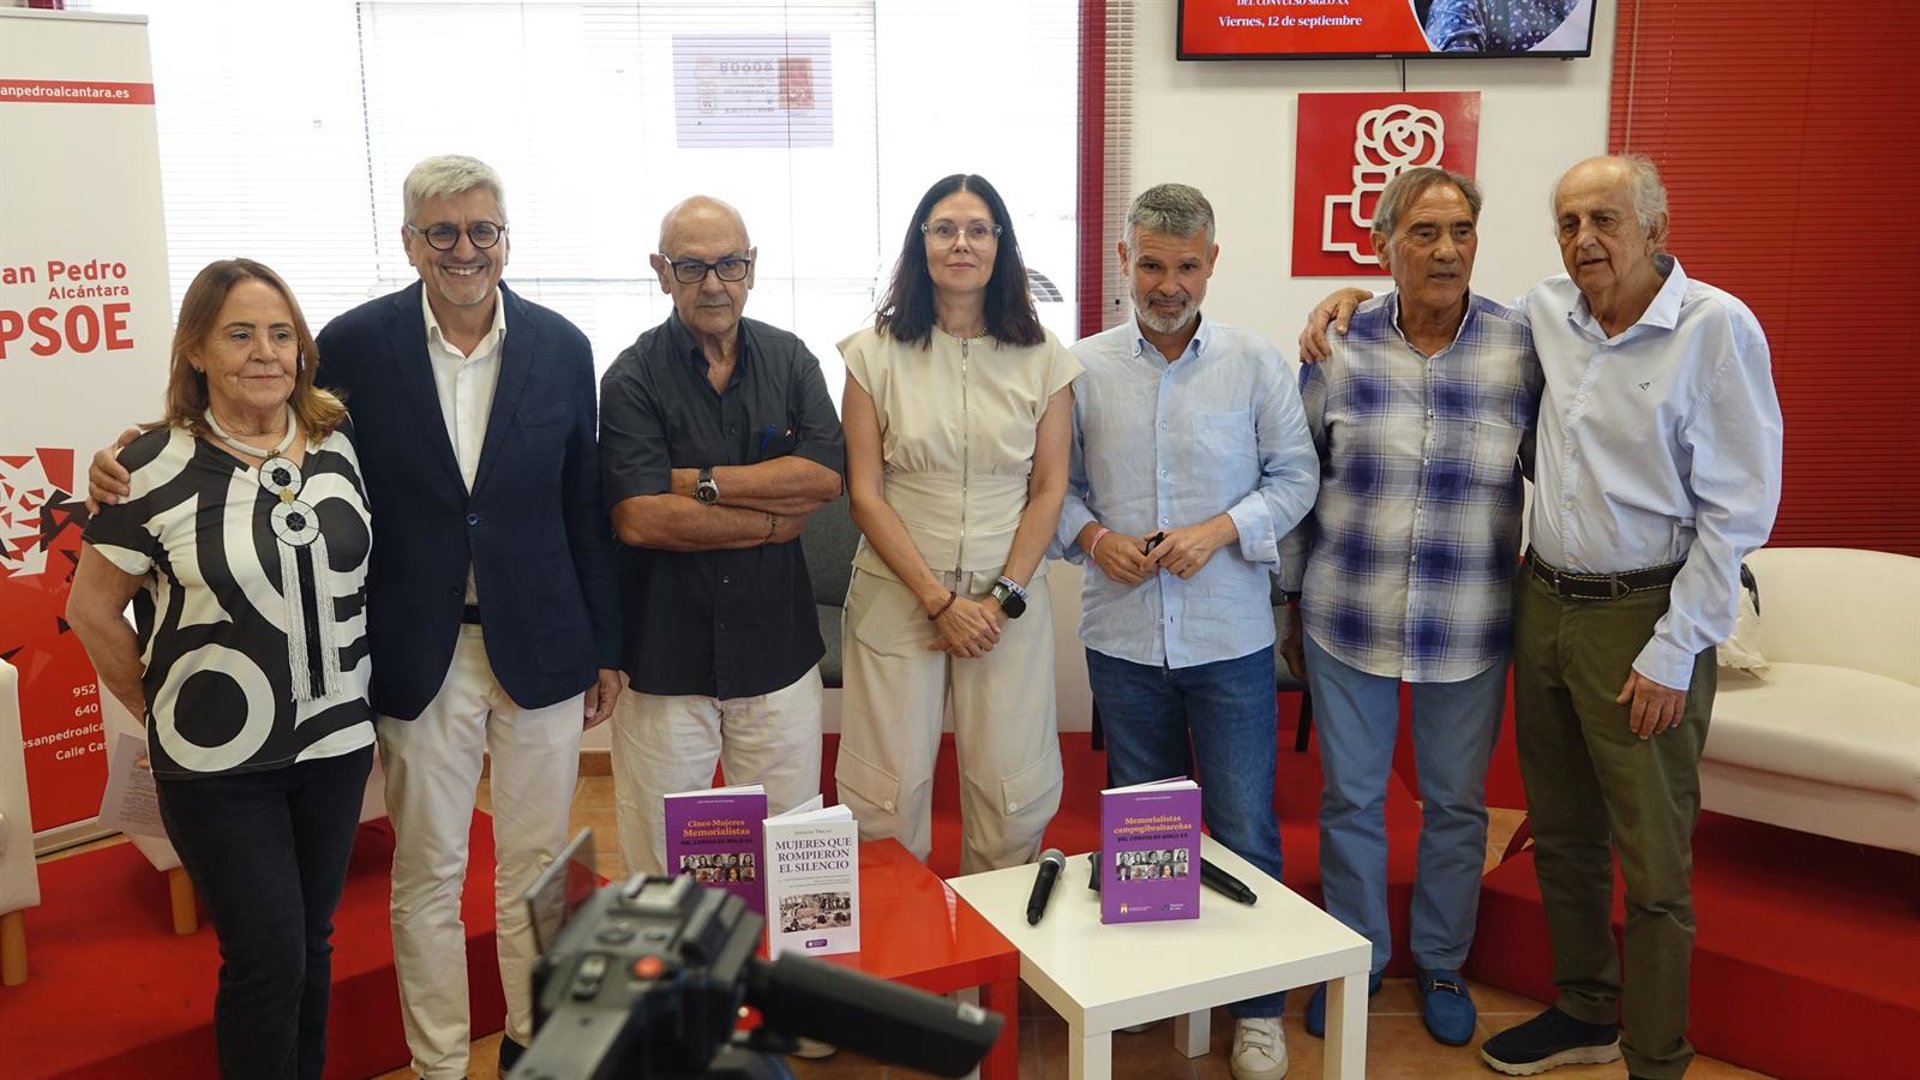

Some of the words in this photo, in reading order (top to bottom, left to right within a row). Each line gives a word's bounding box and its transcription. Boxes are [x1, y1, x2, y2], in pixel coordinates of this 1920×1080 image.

[1219, 16, 1265, 28] Viernes,
[1268, 16, 1279, 26] 12
[1281, 15, 1296, 26] de
[1298, 15, 1362, 28] septiembre
[0, 85, 130, 98] anpedroalcantara.es
[2, 265, 36, 285] an
[48, 259, 127, 282] Pedro
[48, 284, 130, 300] Alcántara
[0, 303, 134, 360] PSOE
[72, 683, 97, 698] 952
[75, 703, 98, 717] 640
[22, 723, 104, 748] esanpedroalca
[56, 746, 85, 760] Calle
[688, 820, 711, 828] Cinco
[712, 818, 745, 828] Mujeres
[1125, 815, 1181, 825] Memorialistas
[683, 827, 750, 837] Memorialistas
[775, 838, 826, 850] MUJERES
[827, 836, 852, 848] QUE
[778, 849, 850, 862] ROMPIERON
[779, 864, 794, 874] EL
[795, 860, 850, 872] SILENCIO
